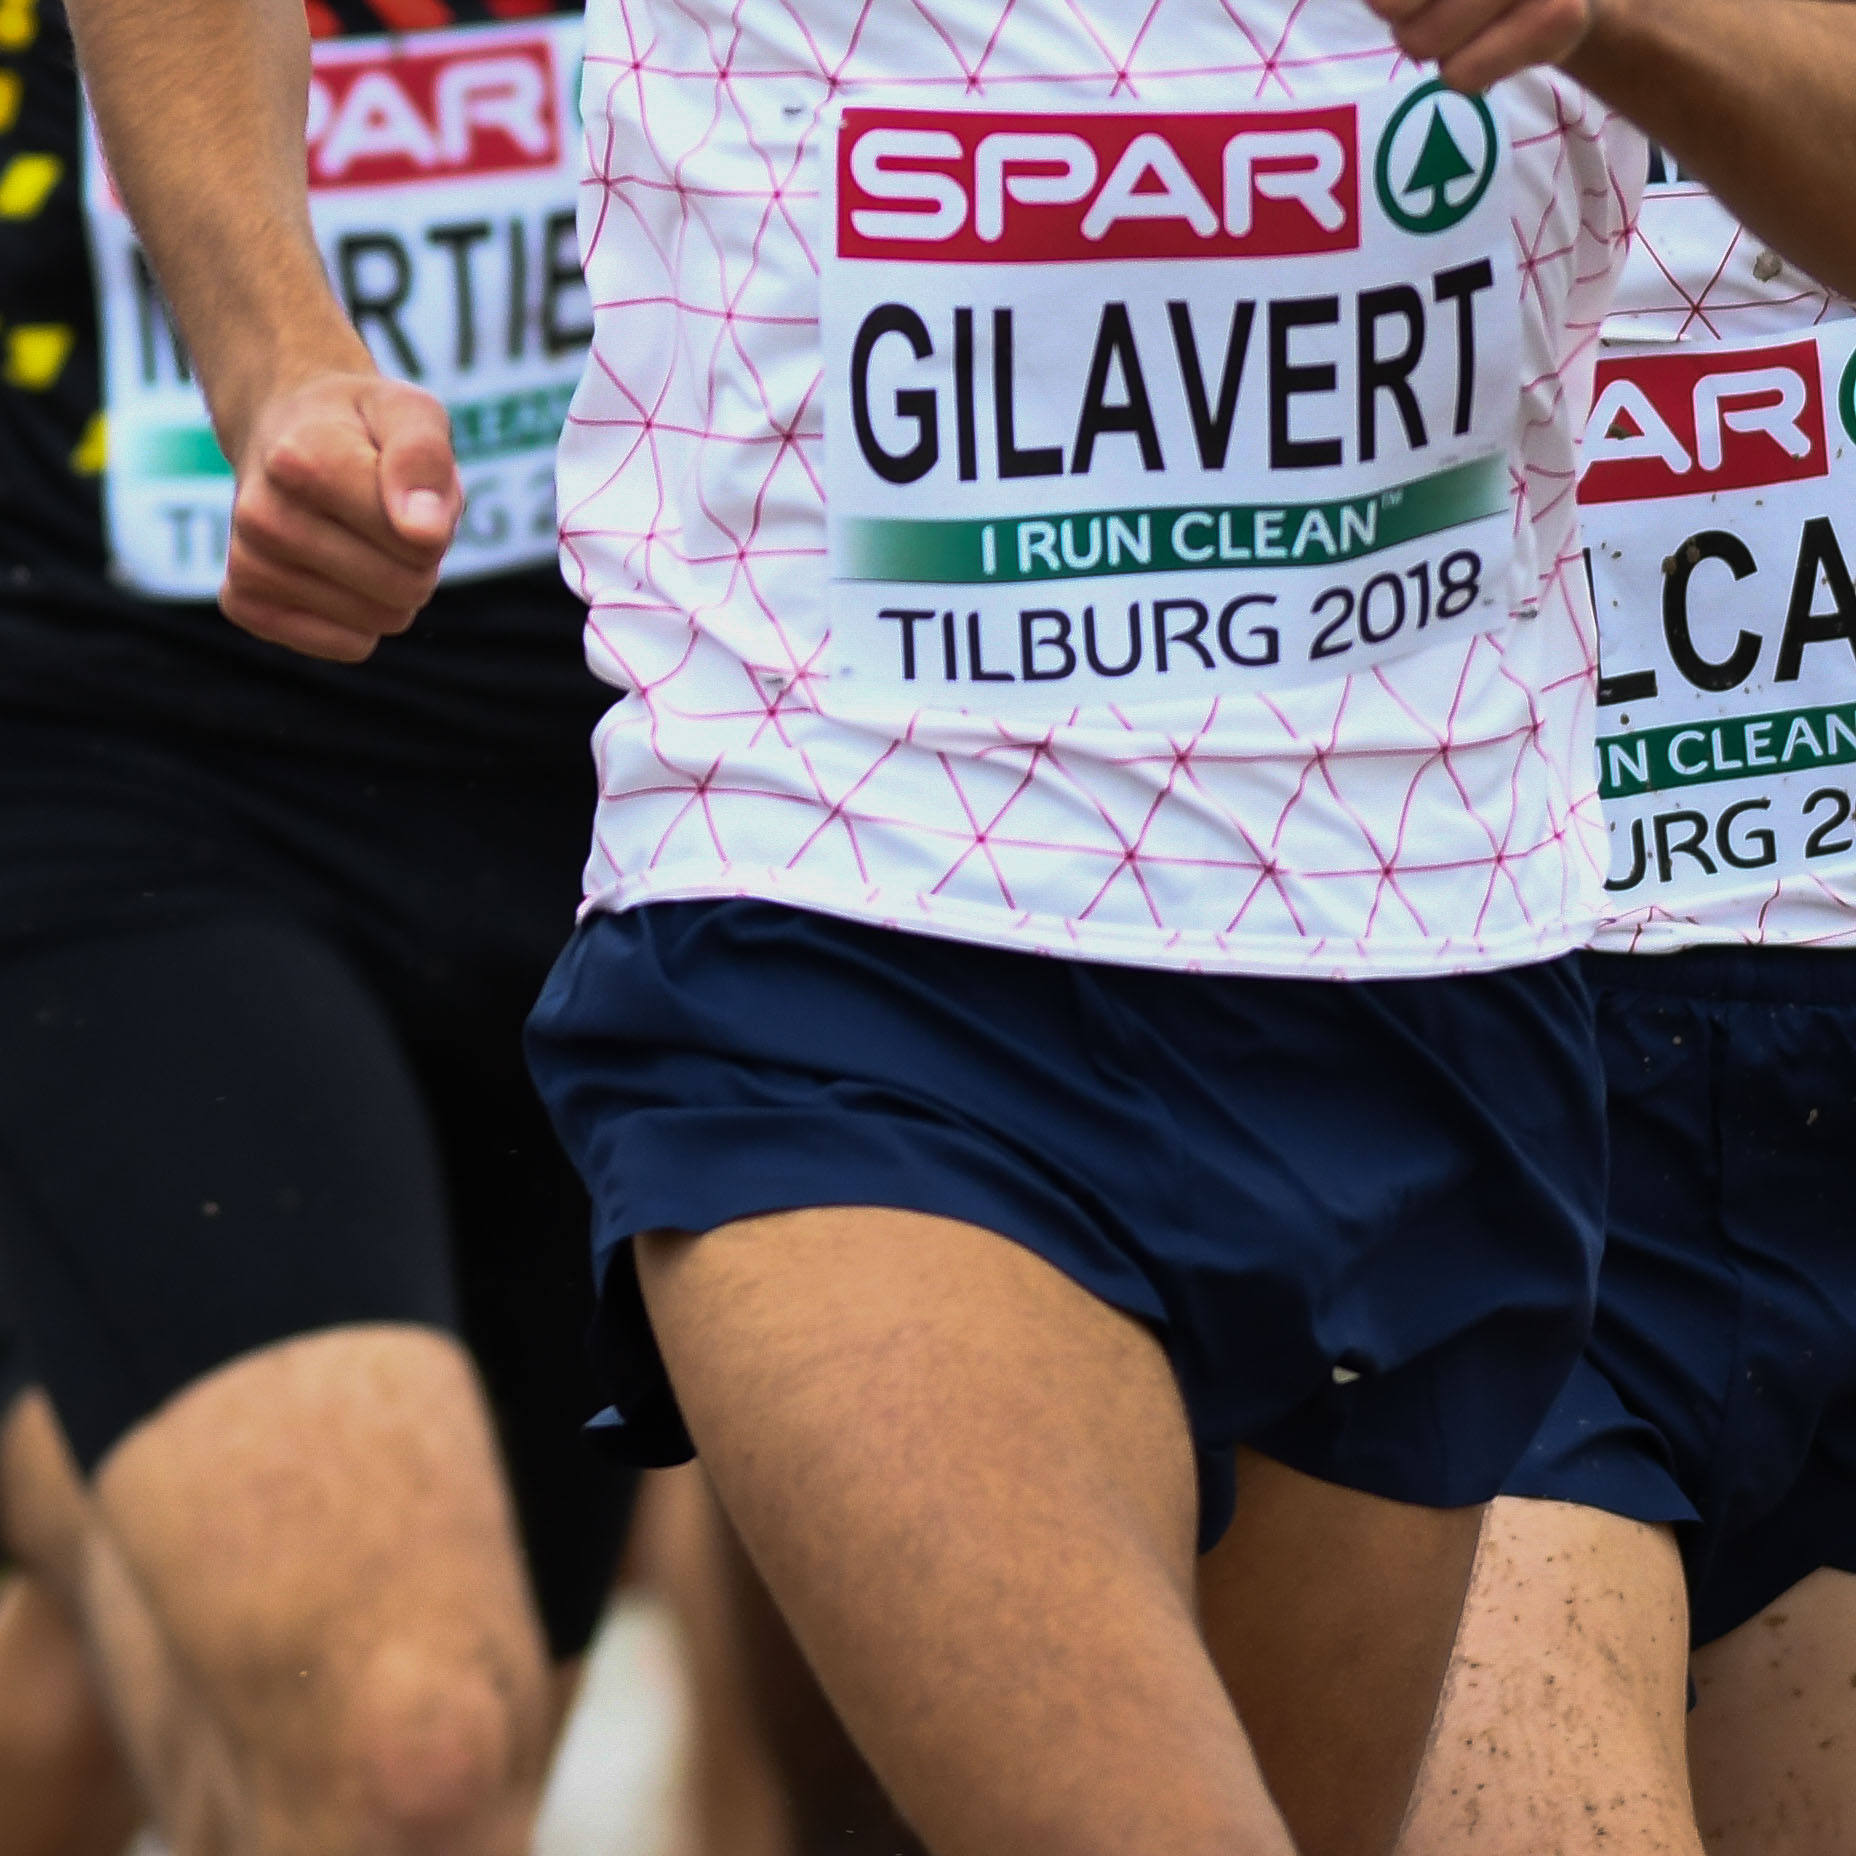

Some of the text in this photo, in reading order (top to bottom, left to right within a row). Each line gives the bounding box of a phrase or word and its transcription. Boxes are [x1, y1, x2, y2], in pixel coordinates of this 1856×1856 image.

[848, 129, 1345, 240] SPAR
[848, 259, 1492, 485] GILAVERT
[981, 522, 996, 575] I
[1016, 512, 1157, 569] RUN
[878, 546, 1481, 684] TILBURG 2018
